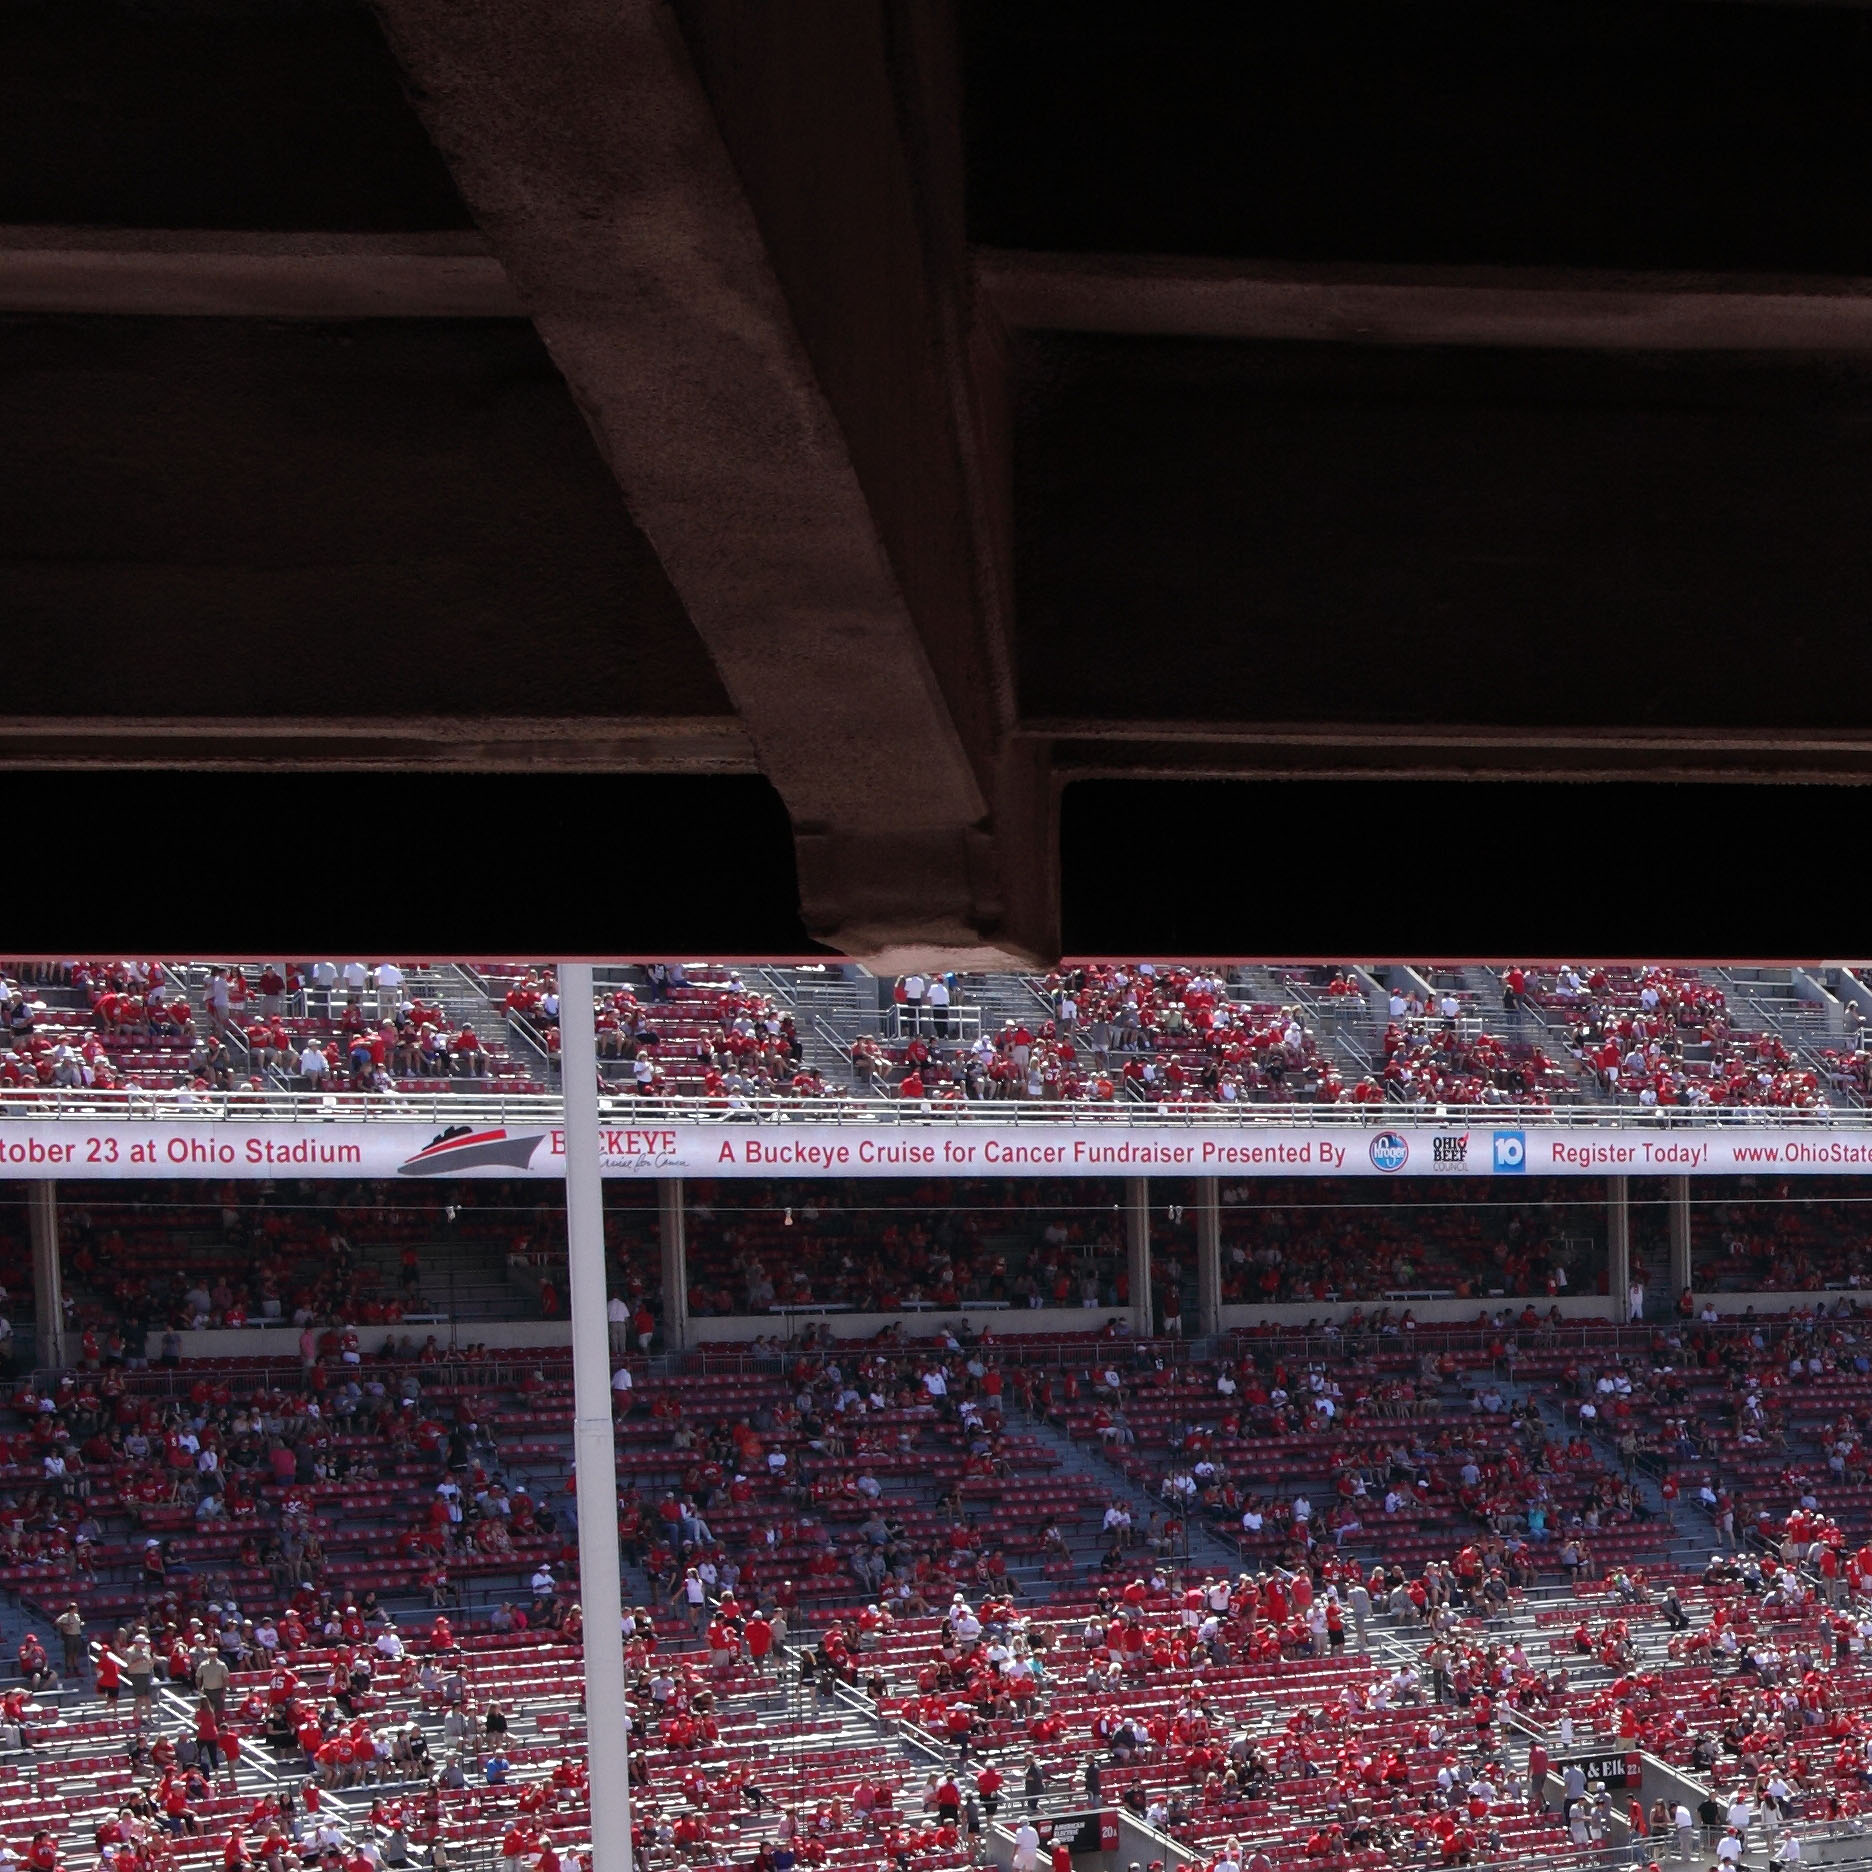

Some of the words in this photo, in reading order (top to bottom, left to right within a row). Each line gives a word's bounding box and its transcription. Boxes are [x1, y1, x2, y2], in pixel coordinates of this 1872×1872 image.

[86, 1137, 119, 1164] 23
[130, 1139, 158, 1164] at
[167, 1137, 236, 1164] Ohio
[246, 1137, 361, 1165] Stadium
[1433, 1136, 1468, 1151] OHIO
[1495, 1138, 1525, 1166] 10
[718, 1140, 735, 1164] A
[746, 1139, 850, 1169] Buckeye
[858, 1139, 937, 1165] Cruise
[943, 1139, 977, 1165] for
[984, 1140, 1065, 1165] Cancer
[1073, 1140, 1195, 1165] Fundraiser
[1202, 1140, 1311, 1165] Presented
[1319, 1141, 1347, 1168] By
[1434, 1149, 1468, 1162] BEEF
[1552, 1141, 1636, 1167] Register
[1640, 1141, 1709, 1168] Today!
[1433, 1161, 1470, 1172] COUNCIL
[270, 1676, 285, 1690] 45
[1587, 1761, 1601, 1780] &
[1602, 1759, 1626, 1779] Elk
[1053, 1821, 1086, 1832] AMERICAN
